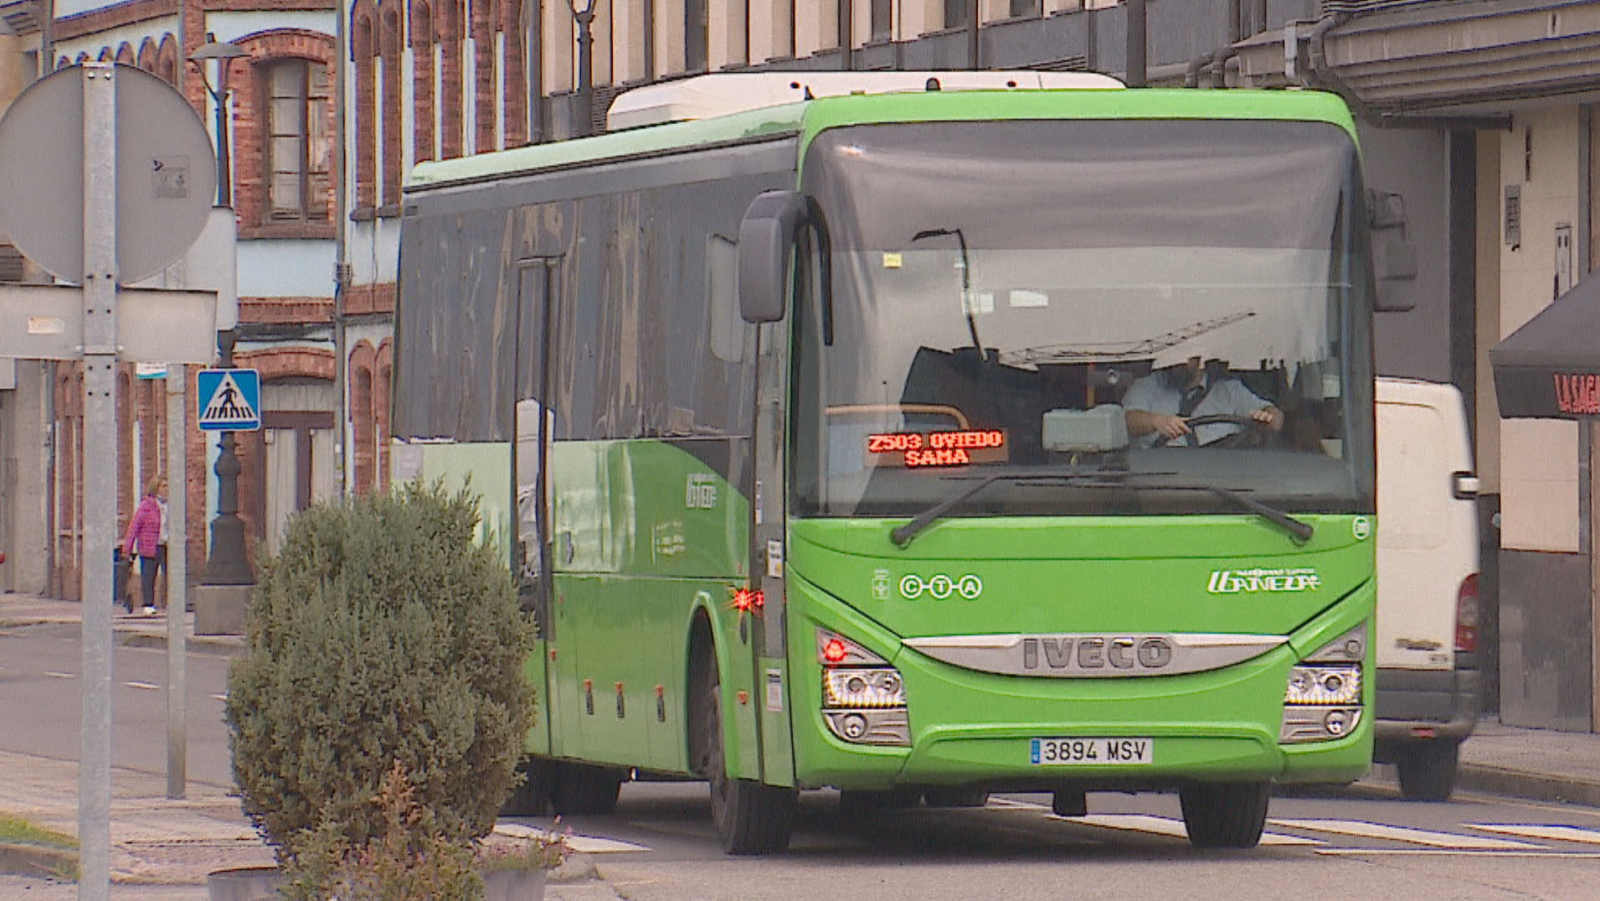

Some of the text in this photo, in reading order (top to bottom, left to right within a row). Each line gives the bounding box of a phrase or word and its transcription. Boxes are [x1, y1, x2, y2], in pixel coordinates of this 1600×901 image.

[929, 431, 1003, 448] OVIEDO
[904, 449, 969, 466] SAMA
[1023, 637, 1173, 670] IVECO
[1045, 741, 1098, 761] 3894
[1107, 741, 1146, 761] MSV
